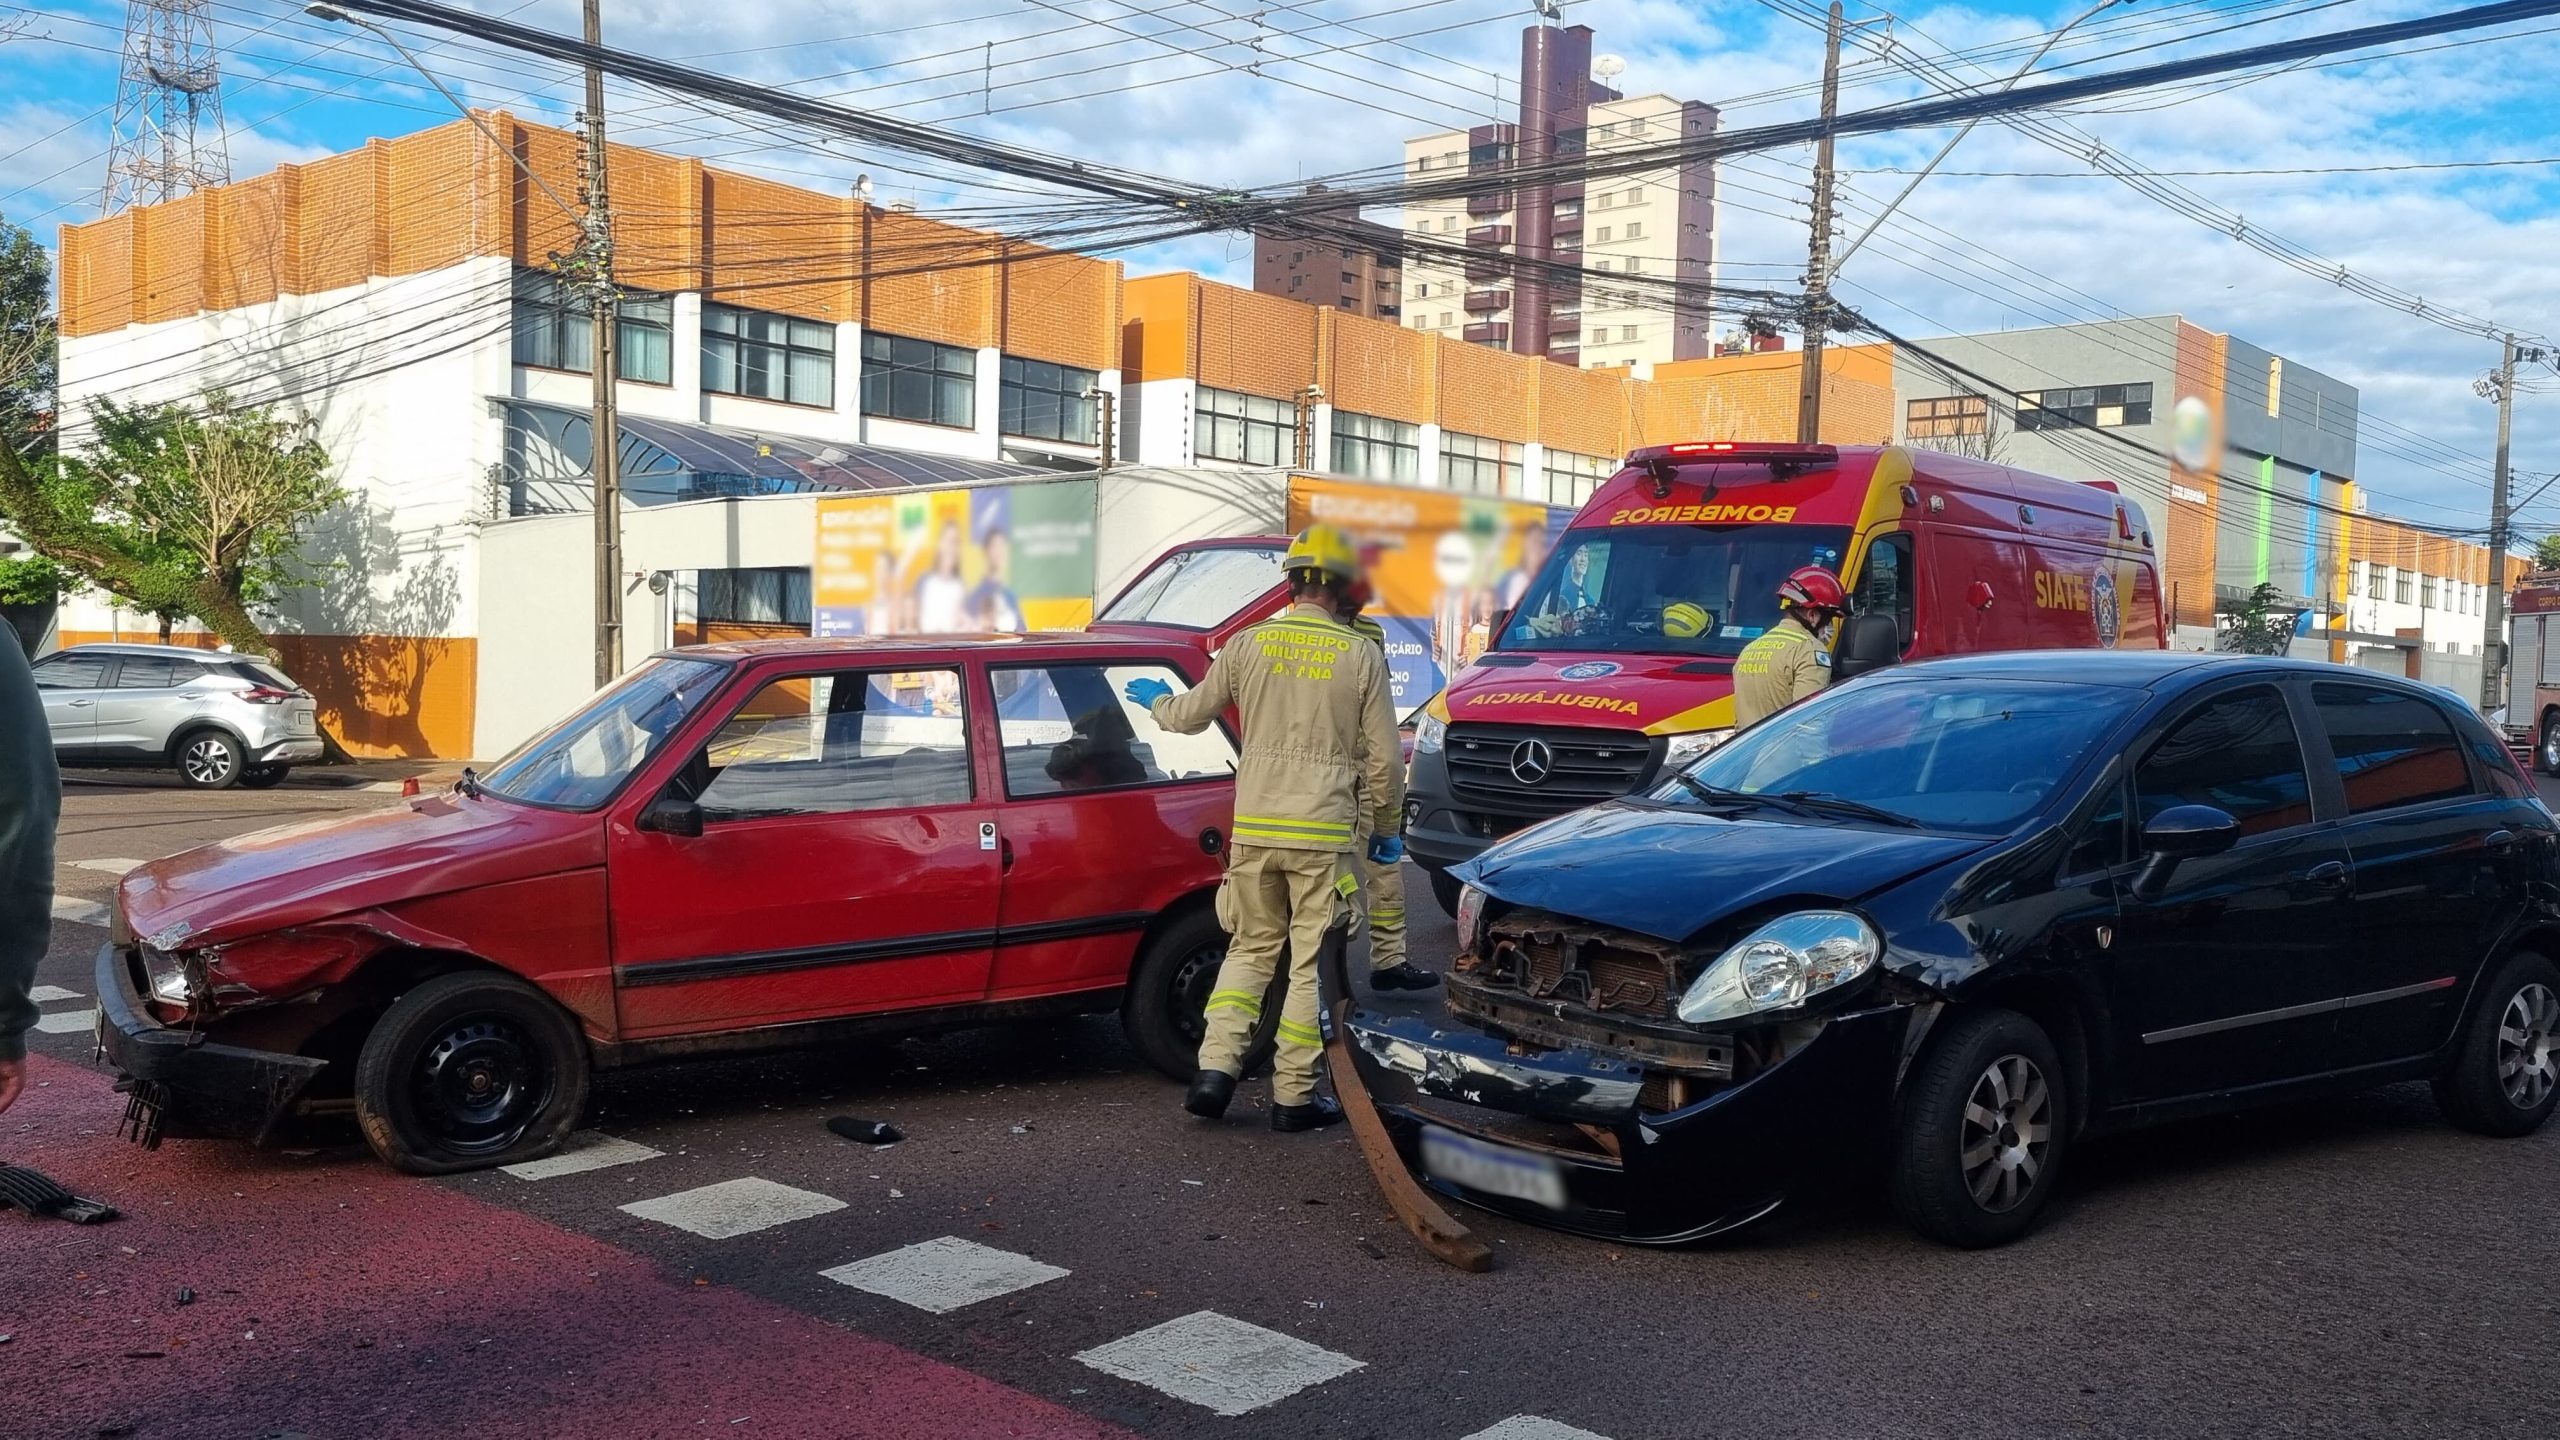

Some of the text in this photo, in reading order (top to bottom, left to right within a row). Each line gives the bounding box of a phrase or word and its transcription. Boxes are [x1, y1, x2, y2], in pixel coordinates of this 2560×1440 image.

[2035, 570, 2086, 611] SIATE
[1263, 644, 1336, 664] MILITAR
[1384, 641, 1423, 658] RÇÁRIO
